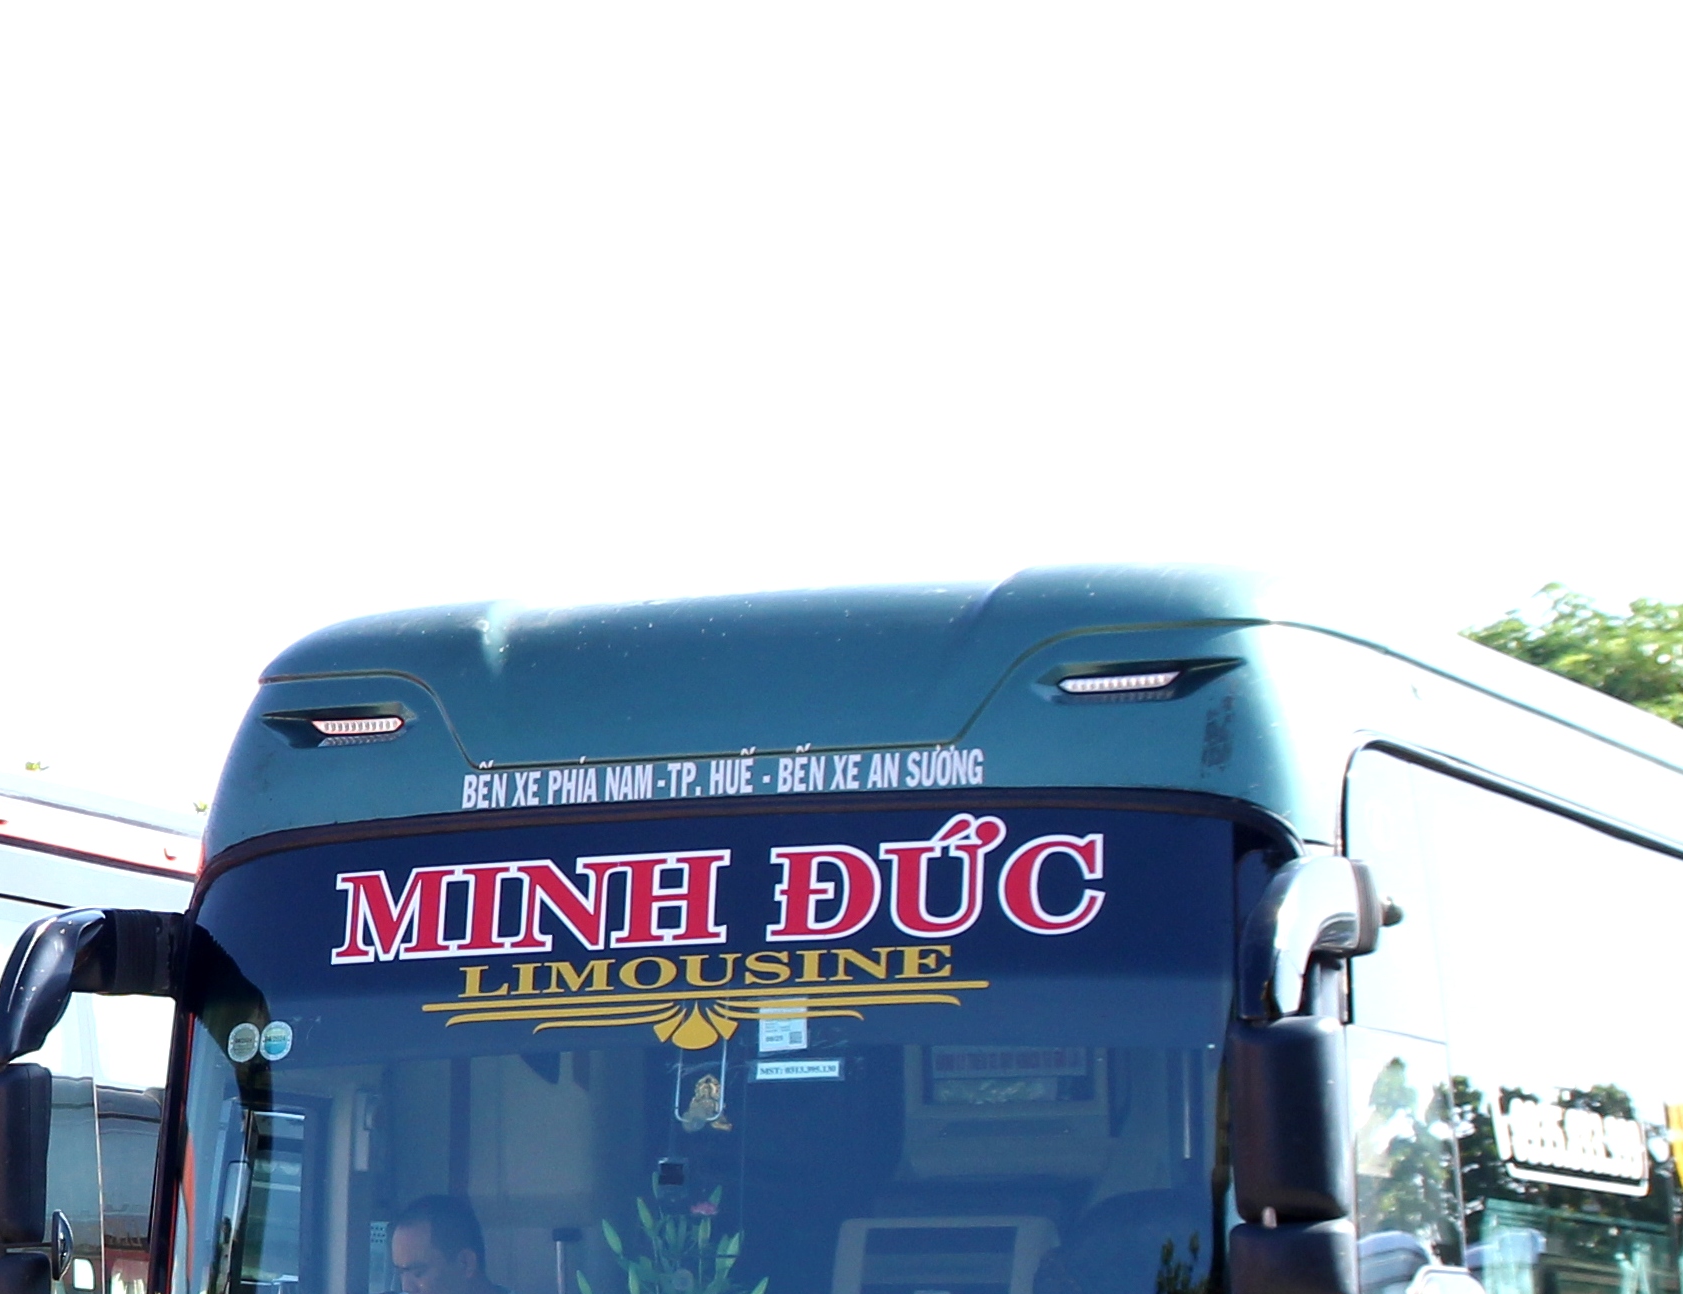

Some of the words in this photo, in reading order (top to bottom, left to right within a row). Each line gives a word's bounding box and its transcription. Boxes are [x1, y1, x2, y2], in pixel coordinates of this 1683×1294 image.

[462, 759, 507, 809] BẾN
[512, 769, 539, 806] XE
[547, 756, 599, 805] PHÍA
[605, 764, 654, 802] NAM
[709, 746, 755, 795] HUẾ
[777, 744, 828, 792] BẾN
[830, 753, 861, 790] XE
[866, 751, 900, 788] AN
[331, 849, 732, 966] MINH
[766, 813, 1106, 943] ĐỨC
[459, 945, 953, 998] LIMOUSINE
